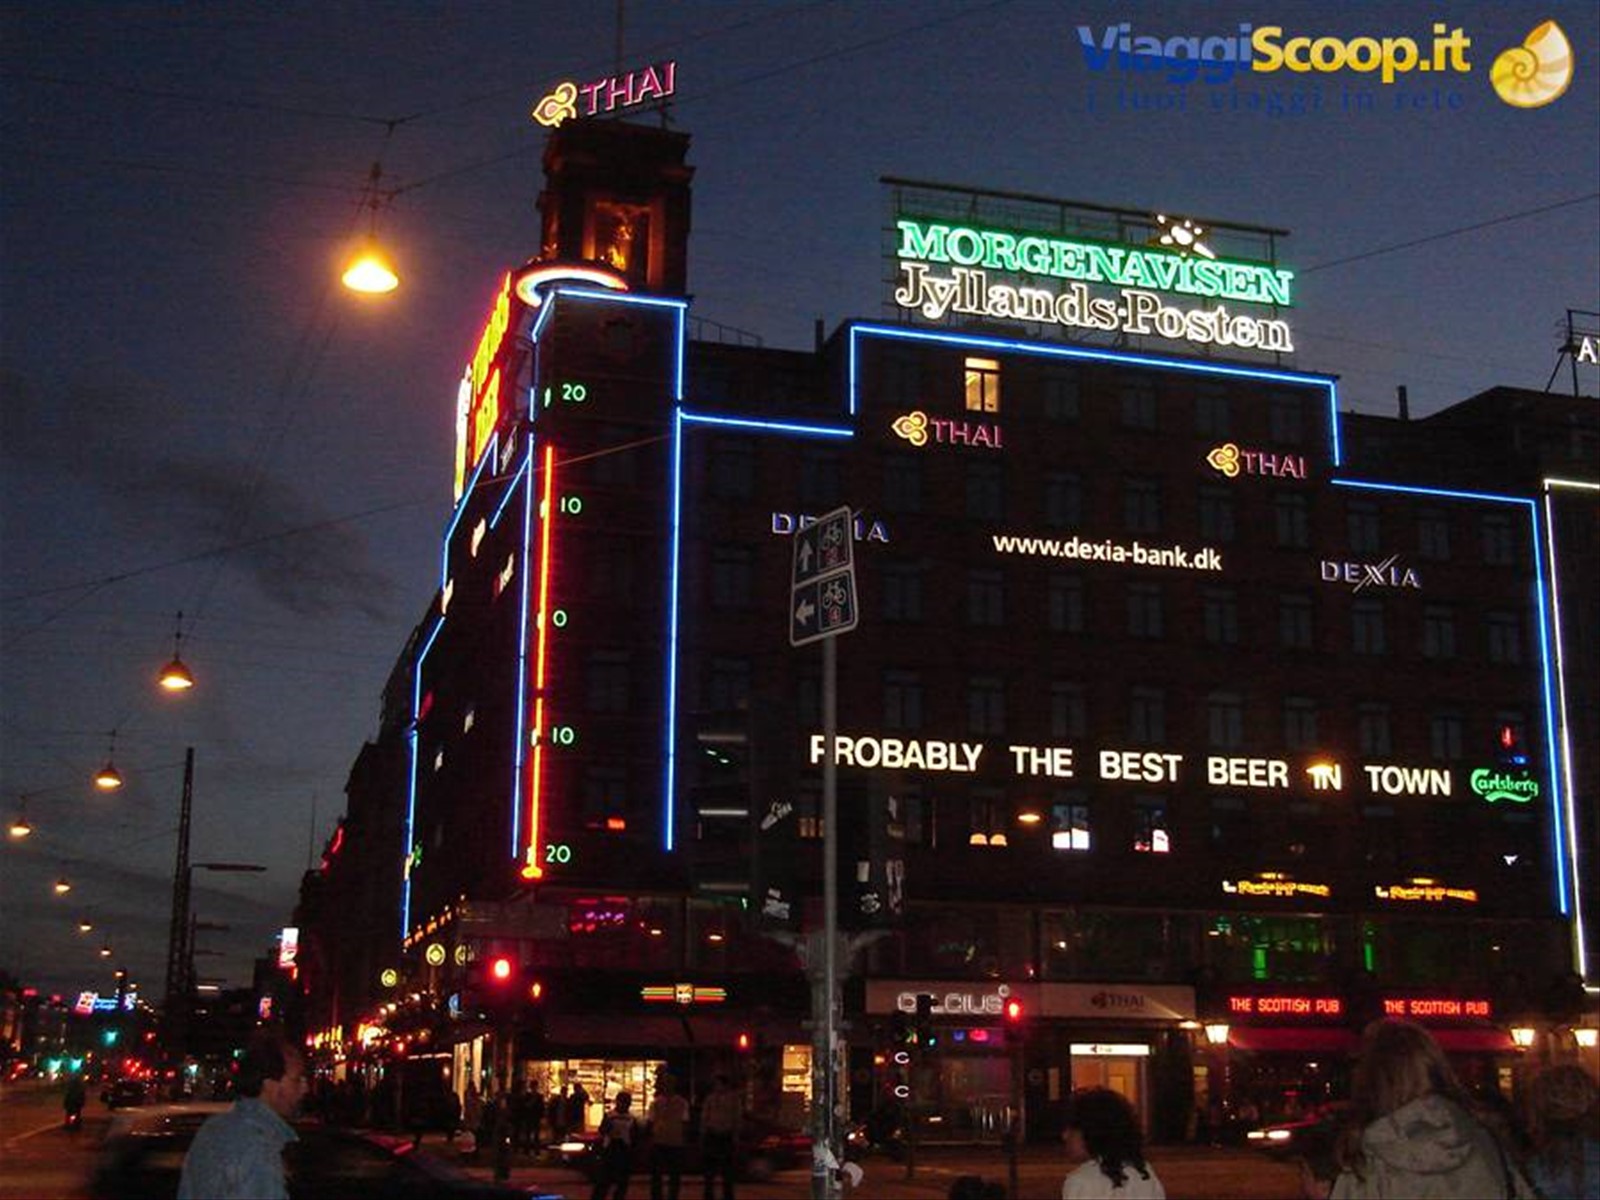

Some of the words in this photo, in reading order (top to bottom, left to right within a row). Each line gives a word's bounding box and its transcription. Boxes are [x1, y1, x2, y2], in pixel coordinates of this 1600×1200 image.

[579, 61, 677, 116] THAI
[896, 220, 1294, 306] MORGENAVISEN
[562, 383, 587, 402] 20
[930, 417, 1004, 449] THAI
[1238, 449, 1308, 480] THAI
[560, 496, 582, 514] 10
[992, 534, 1223, 572] www.dexia-bank.dk
[1320, 554, 1422, 594] DEXIA
[552, 609, 568, 627] 0
[552, 726, 575, 745] 10
[809, 734, 984, 772] PROBABLY
[1008, 745, 1074, 777] THE
[1099, 750, 1183, 782] BEST
[1207, 756, 1289, 788] BEER
[1308, 764, 1342, 790] IN
[1363, 765, 1452, 796] TOWN
[1470, 768, 1539, 802] Carlsberg
[545, 844, 571, 863] 20
[1230, 997, 1252, 1012] THE
[1257, 997, 1311, 1013] SCOTTISH
[1315, 999, 1340, 1014] PUB
[1384, 1000, 1406, 1015] THE
[1410, 1000, 1462, 1015] SCOTTISH
[1465, 1001, 1489, 1015] PUB
